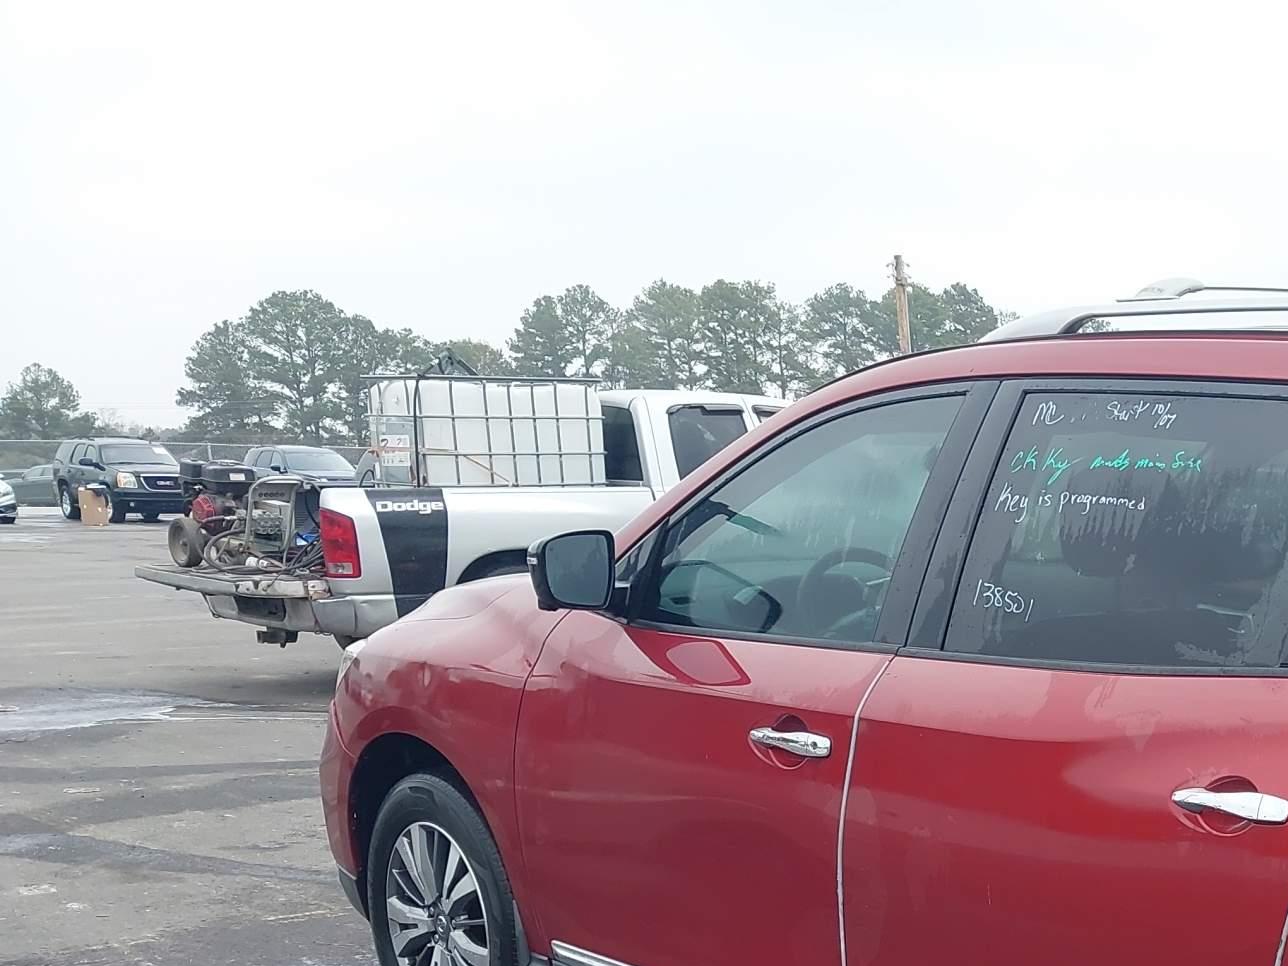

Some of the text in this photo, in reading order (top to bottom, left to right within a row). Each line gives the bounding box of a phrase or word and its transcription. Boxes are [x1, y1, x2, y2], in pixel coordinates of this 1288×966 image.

[376, 500, 444, 515] Dodge
[994, 482, 1146, 523] Key is programmed
[973, 579, 1034, 622] 138501
